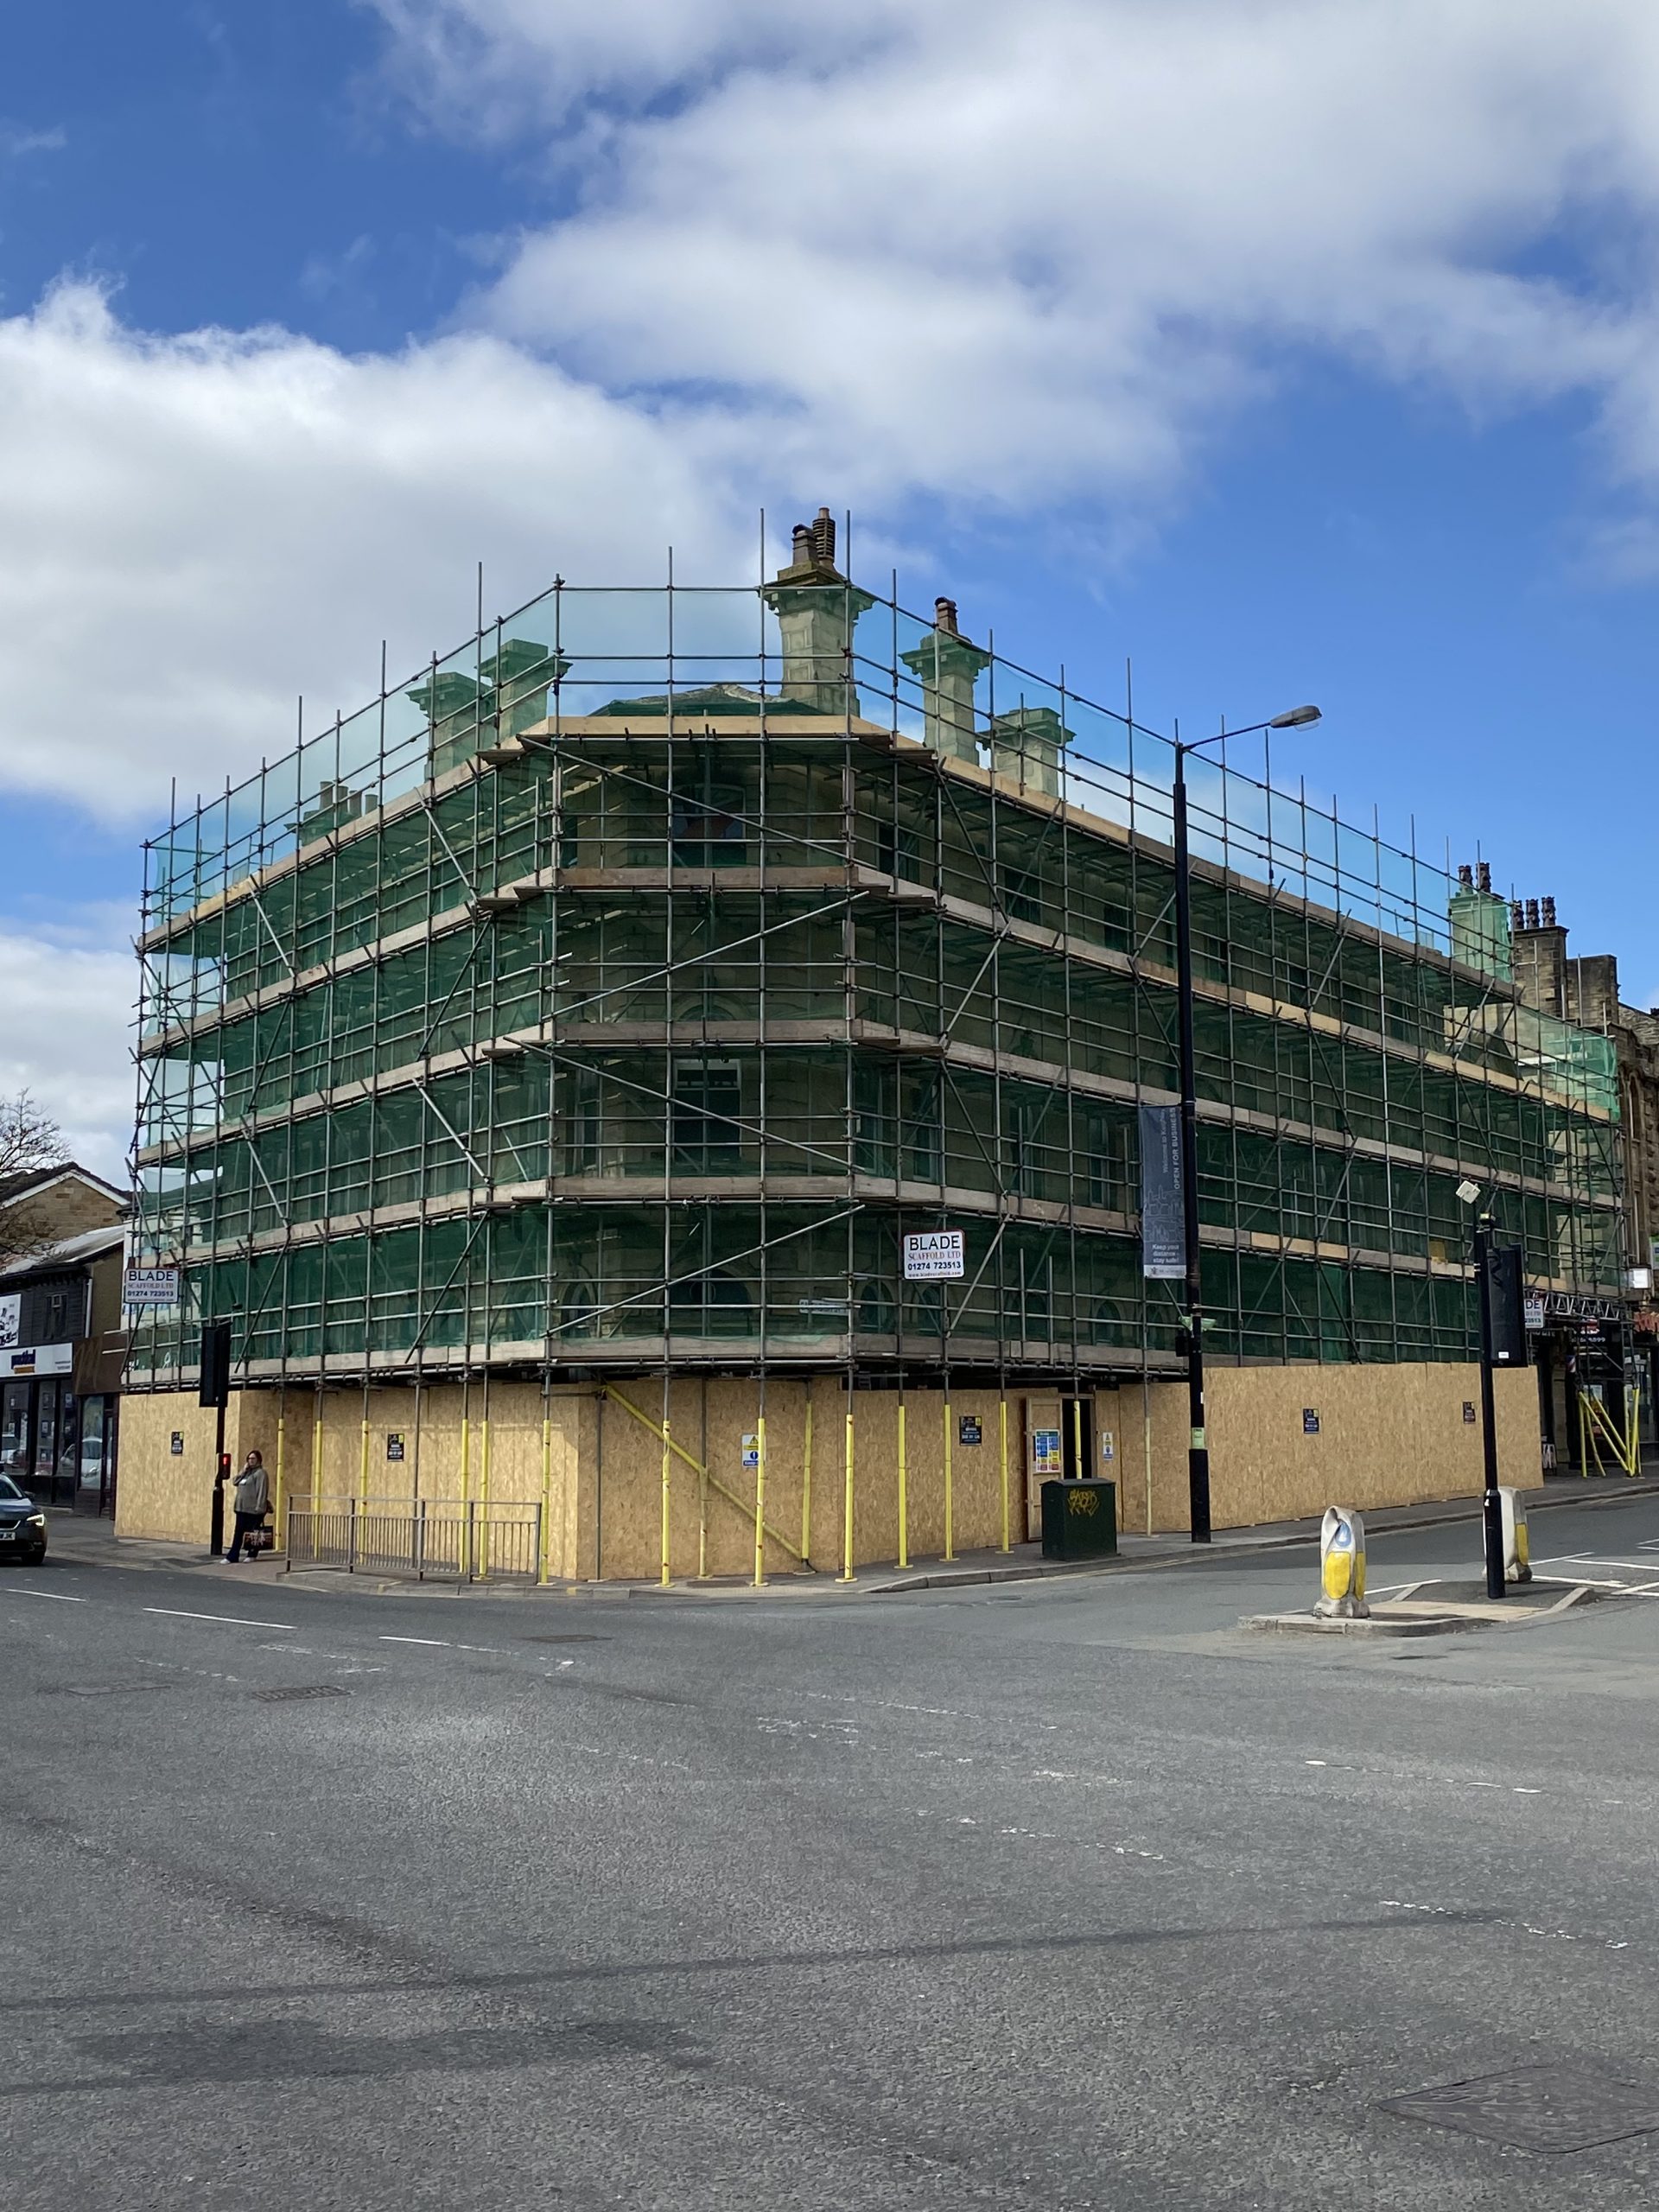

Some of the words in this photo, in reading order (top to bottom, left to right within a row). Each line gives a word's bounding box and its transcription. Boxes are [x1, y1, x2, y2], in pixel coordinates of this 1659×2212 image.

[1169, 1108, 1179, 1147] BUSINESS
[910, 1235, 961, 1250] BLADE
[908, 1251, 945, 1261] SCAFFOLD
[129, 1270, 175, 1281] BLADE
[1525, 1300, 1541, 1309] DE
